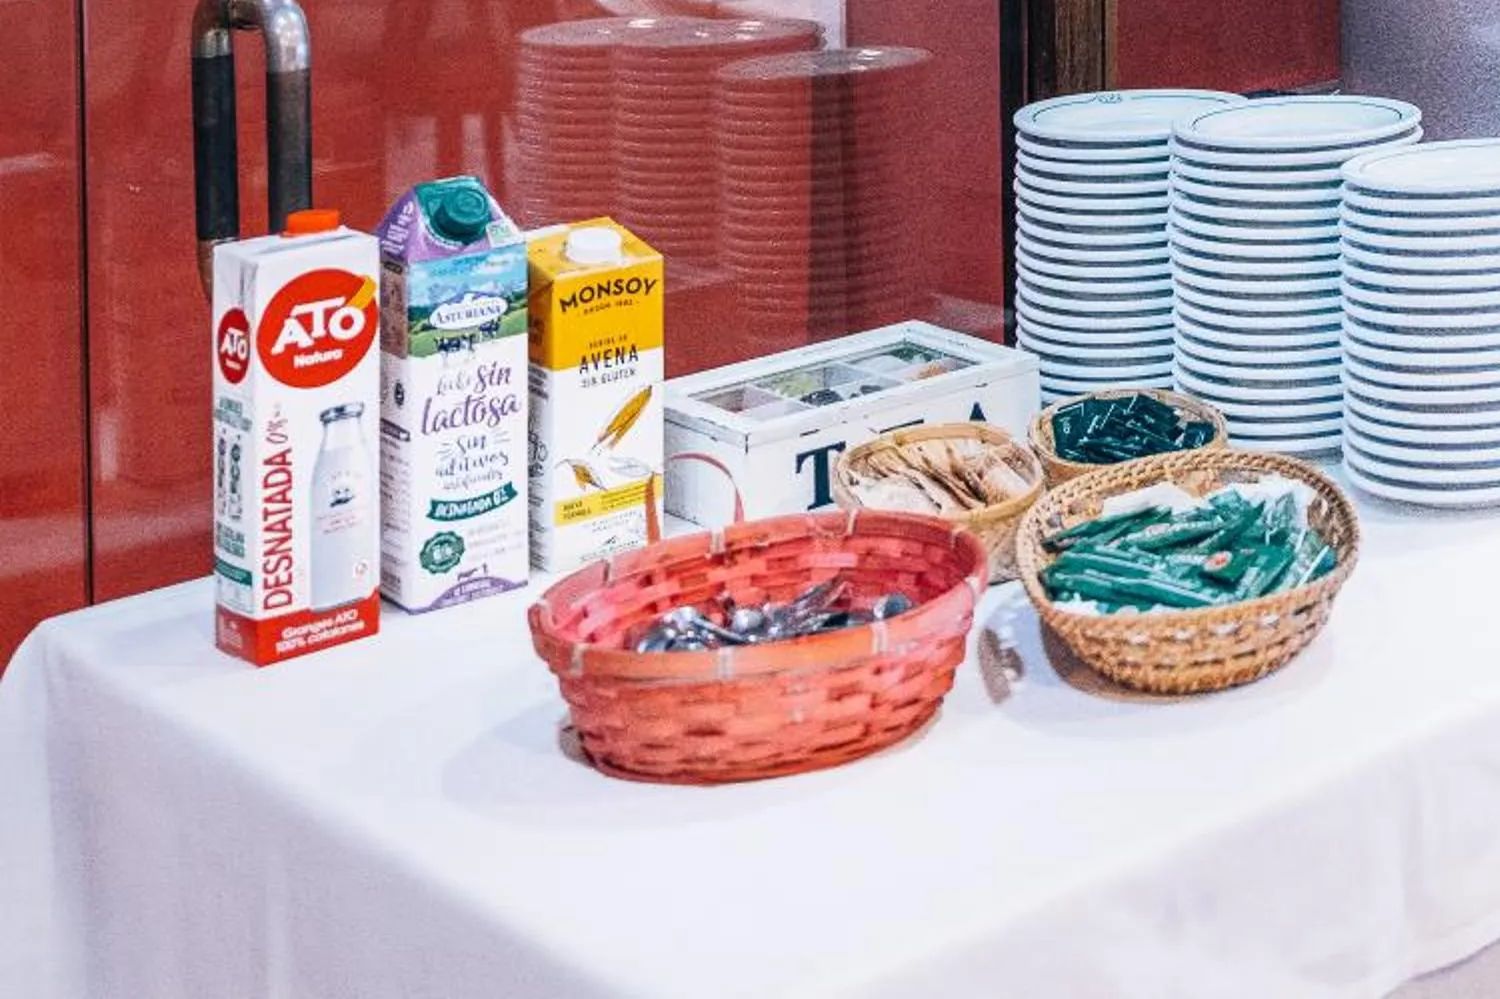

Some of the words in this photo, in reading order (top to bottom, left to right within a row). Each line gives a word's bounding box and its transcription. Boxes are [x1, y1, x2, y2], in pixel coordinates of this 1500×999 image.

[559, 276, 658, 313] MONSOY
[220, 327, 247, 361] ATO
[271, 296, 366, 356] ATO
[293, 349, 344, 369] Natura
[579, 344, 639, 374] AVENA
[420, 393, 521, 436] lactosa
[262, 448, 293, 610] DESNATADA
